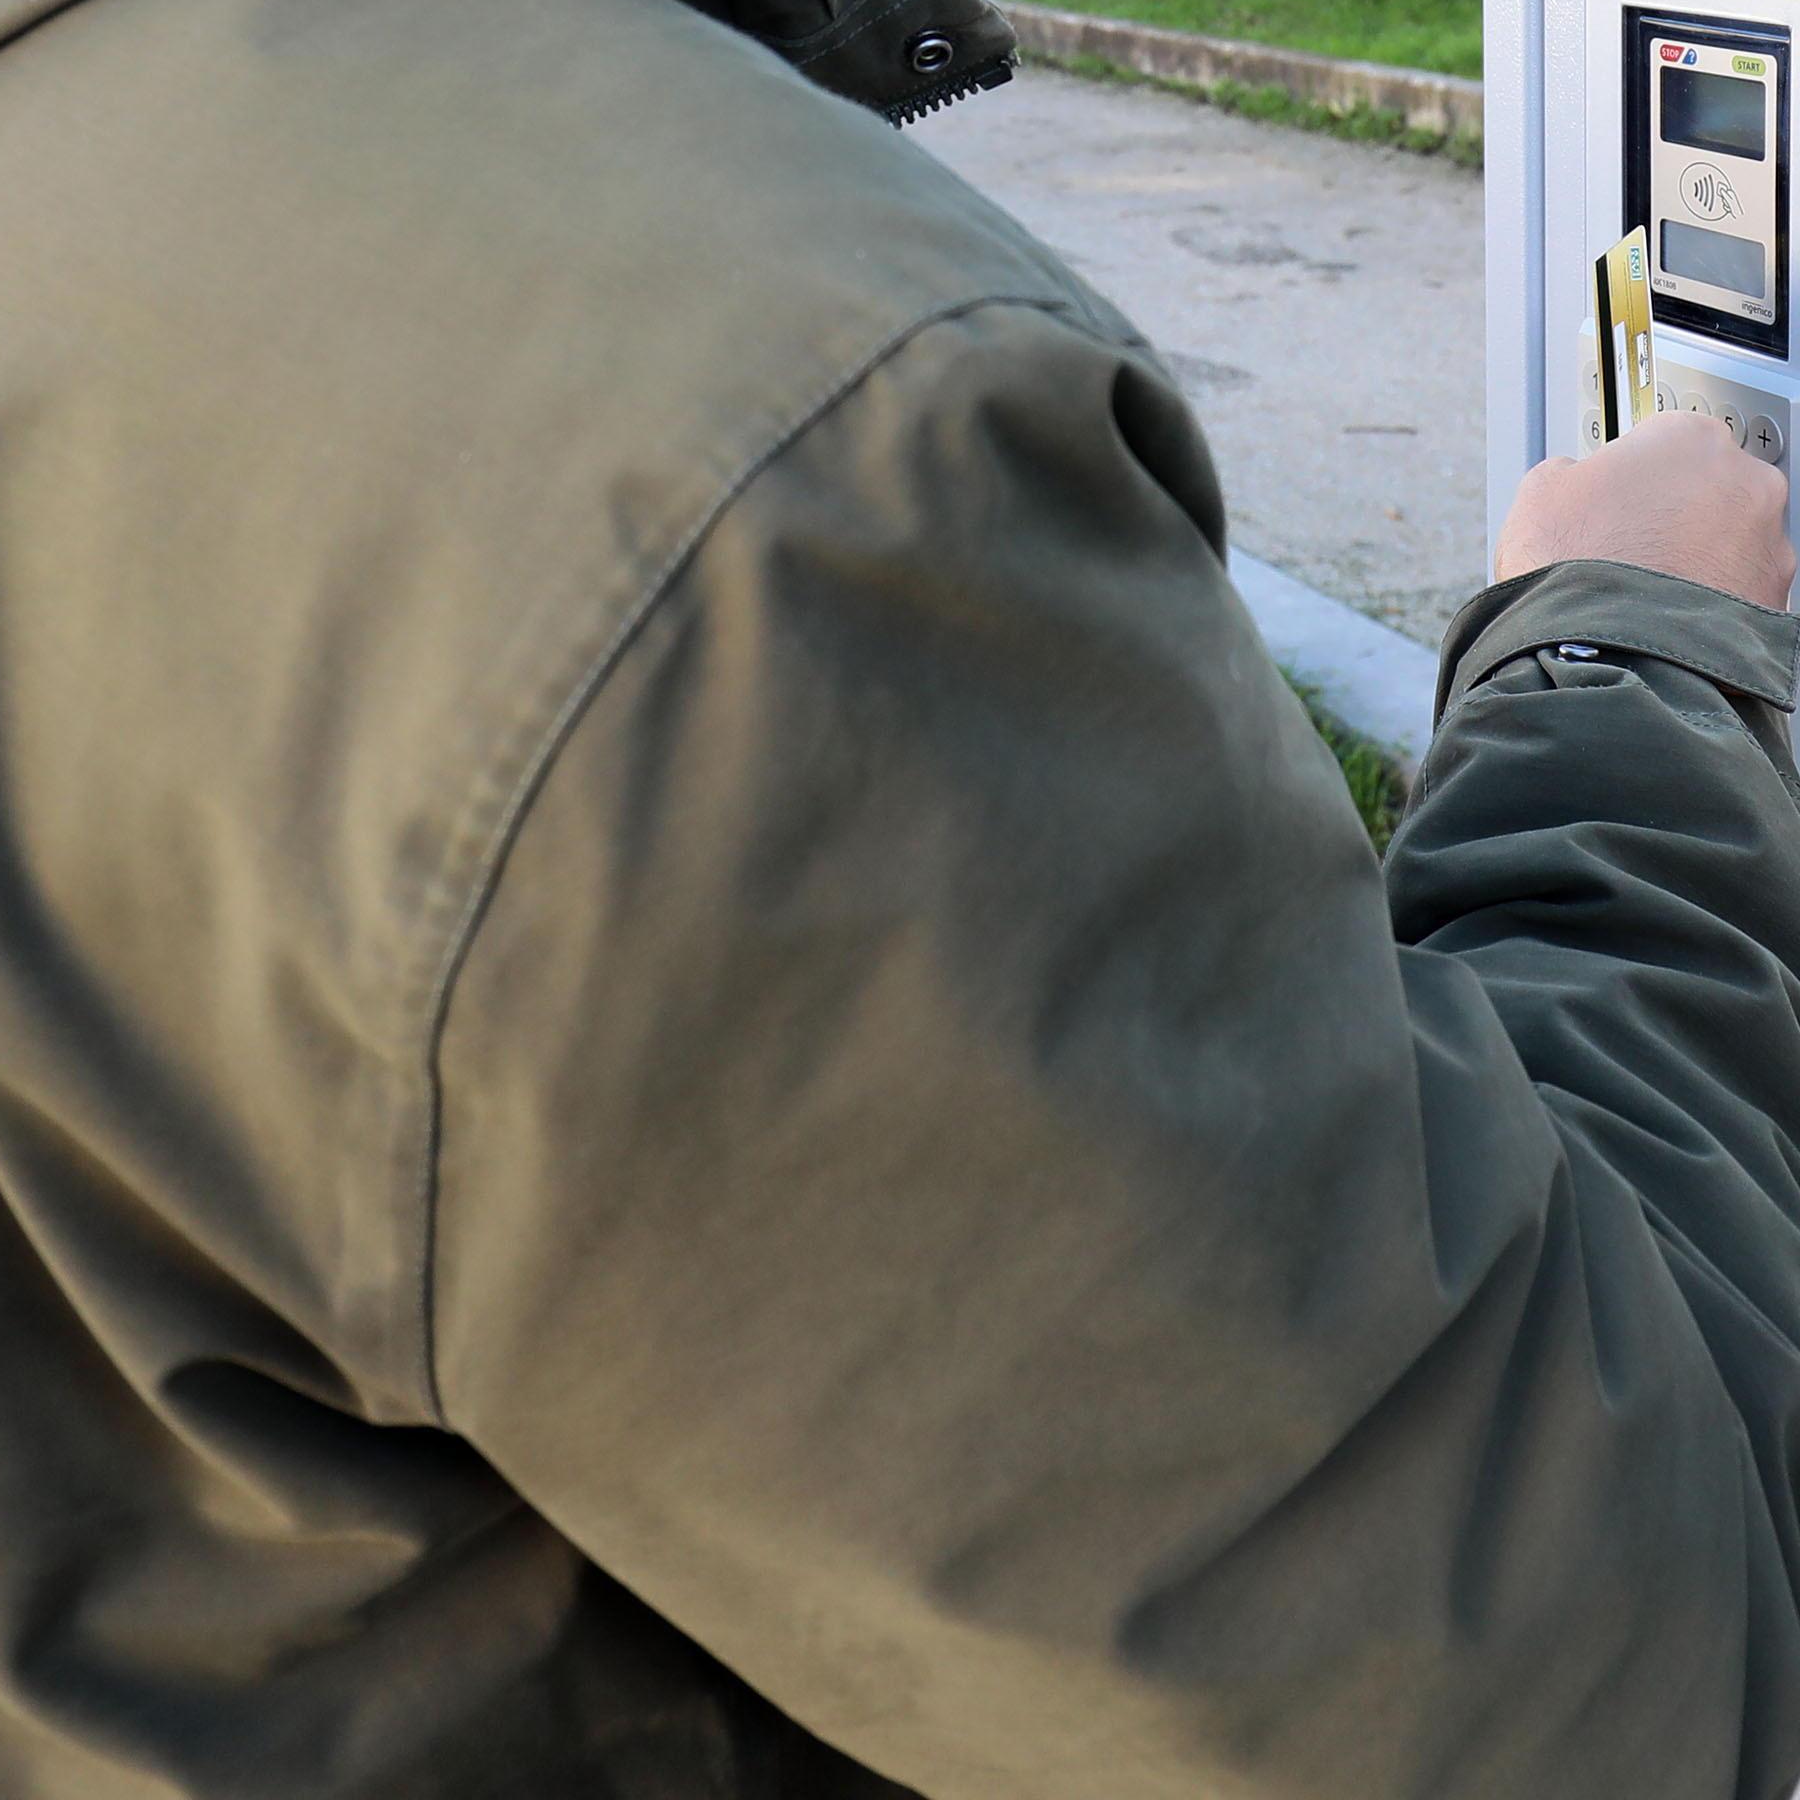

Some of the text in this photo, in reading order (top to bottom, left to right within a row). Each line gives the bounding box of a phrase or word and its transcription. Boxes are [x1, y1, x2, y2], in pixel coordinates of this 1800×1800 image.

[1661, 46, 1680, 56] STOP
[1737, 60, 1761, 72] START
[1741, 302, 1773, 318] ingenico
